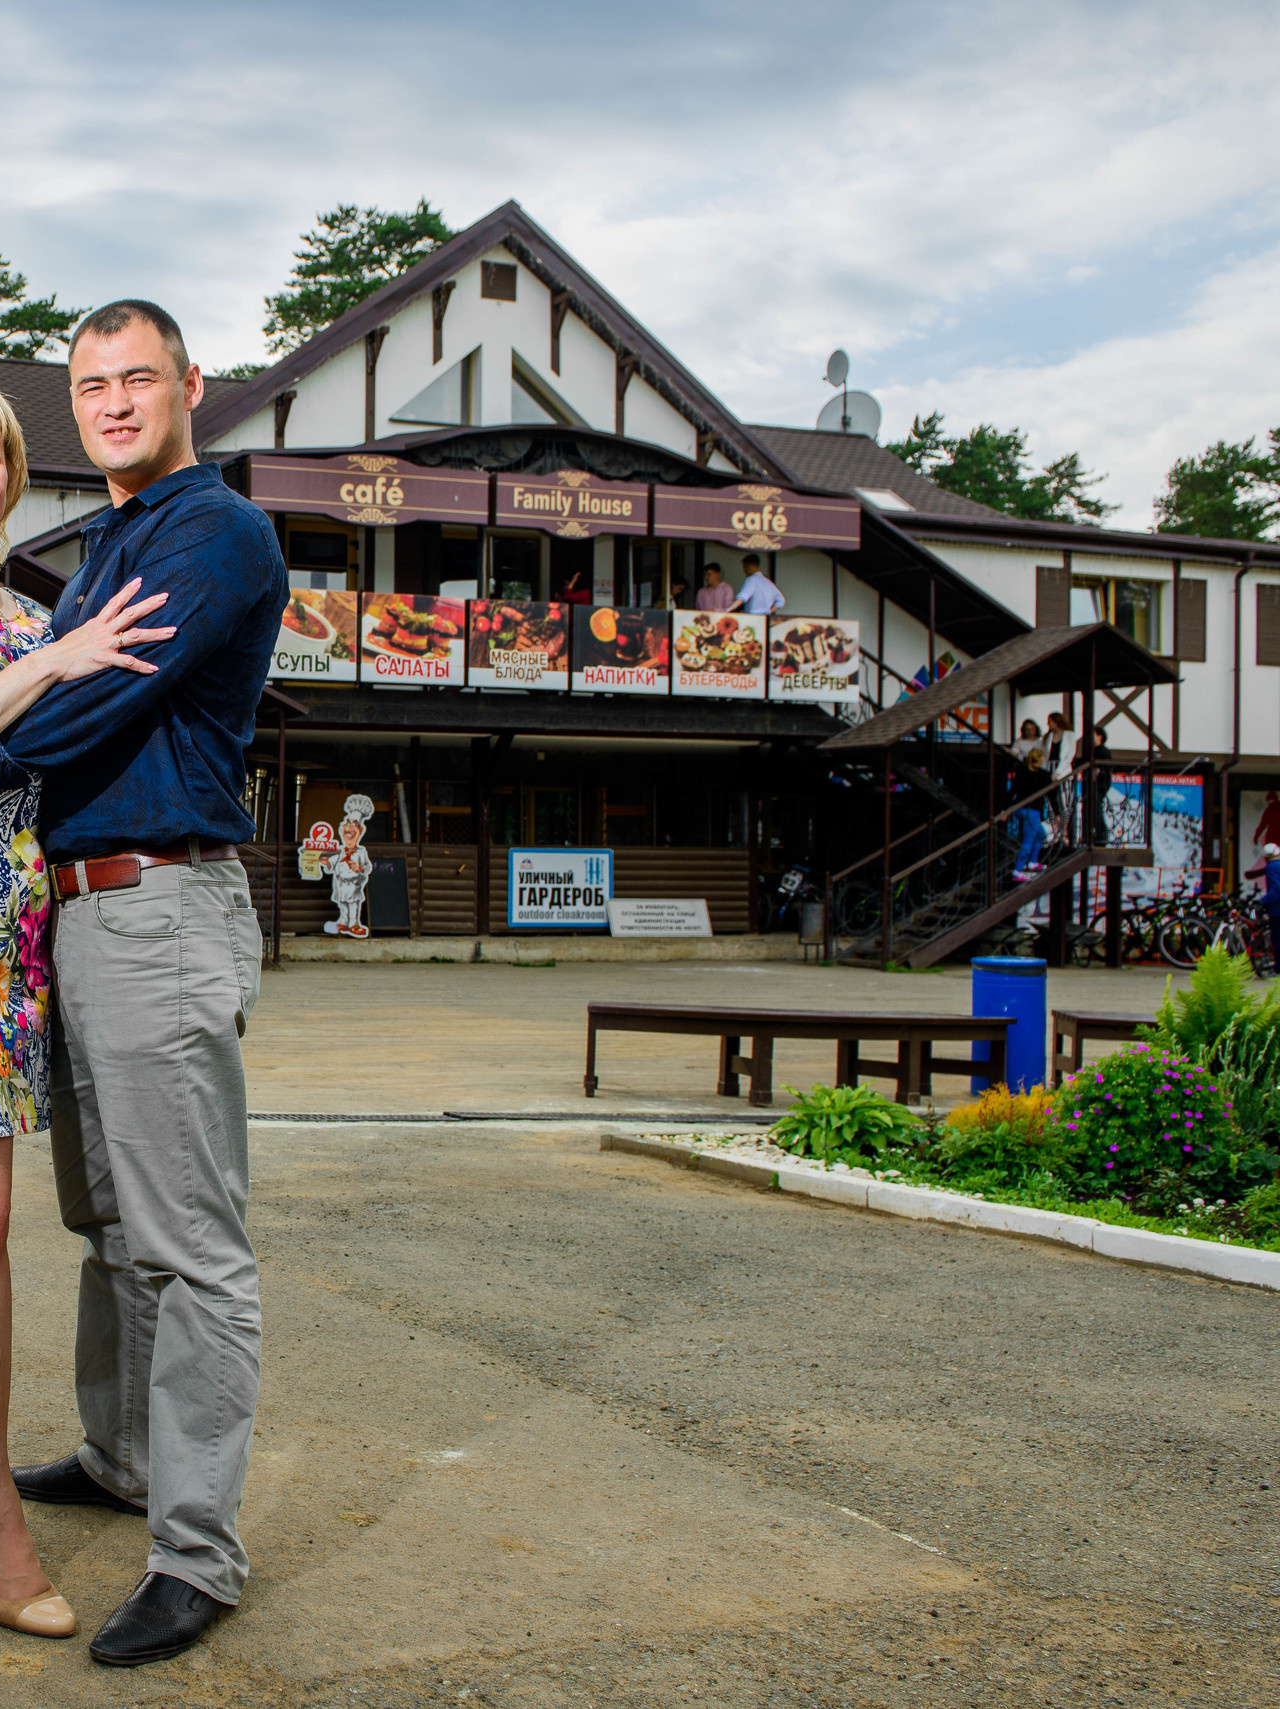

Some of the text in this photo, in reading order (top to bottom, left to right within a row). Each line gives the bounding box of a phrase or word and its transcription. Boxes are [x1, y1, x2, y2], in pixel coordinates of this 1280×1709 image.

[340, 476, 404, 506] café
[513, 487, 633, 517] Family House
[731, 505, 788, 533] café
[375, 656, 450, 678] САЛАТЫ
[490, 650, 548, 667] МЯСНЫЕ
[495, 666, 543, 682] БЛЮДА
[584, 667, 656, 686] НАПИТКИ
[679, 673, 758, 690] БУТЕРБРОДЫ
[782, 674, 848, 692] ДЕСЕРТЫ
[315, 826, 329, 841] 2
[307, 841, 336, 850] ЭТАЖ
[518, 869, 574, 885] УЛИЧНЫЙ
[518, 887, 605, 910] ГАРДЕРОБ
[518, 910, 605, 920] outdoor cloakroom
